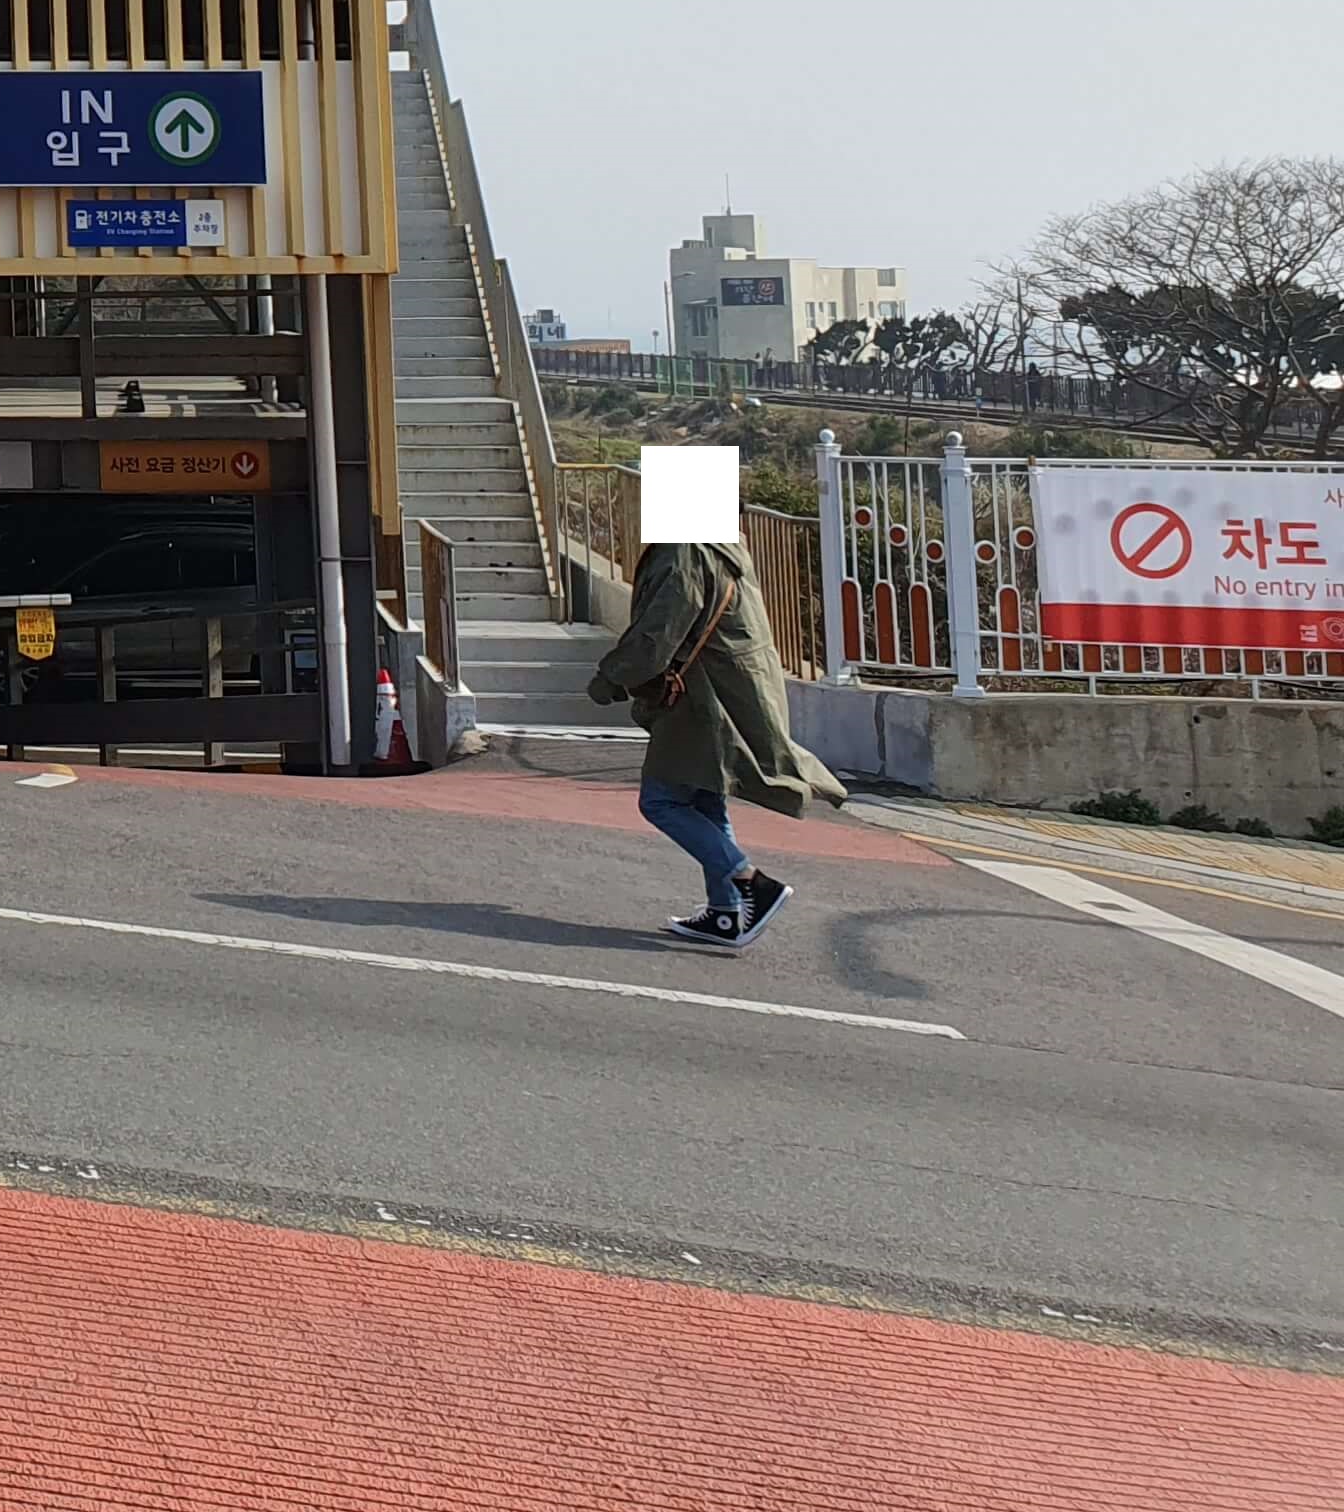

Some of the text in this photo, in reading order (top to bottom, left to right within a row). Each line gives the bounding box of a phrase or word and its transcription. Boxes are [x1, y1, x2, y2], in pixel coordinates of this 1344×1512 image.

[61, 89, 113, 125] IN
[96, 210, 182, 227] 전기차충전소
[110, 456, 226, 474] 사전 요금 정산기
[1220, 517, 1328, 571] 차도
[1214, 574, 1247, 596] No
[1254, 578, 1316, 602] entry
